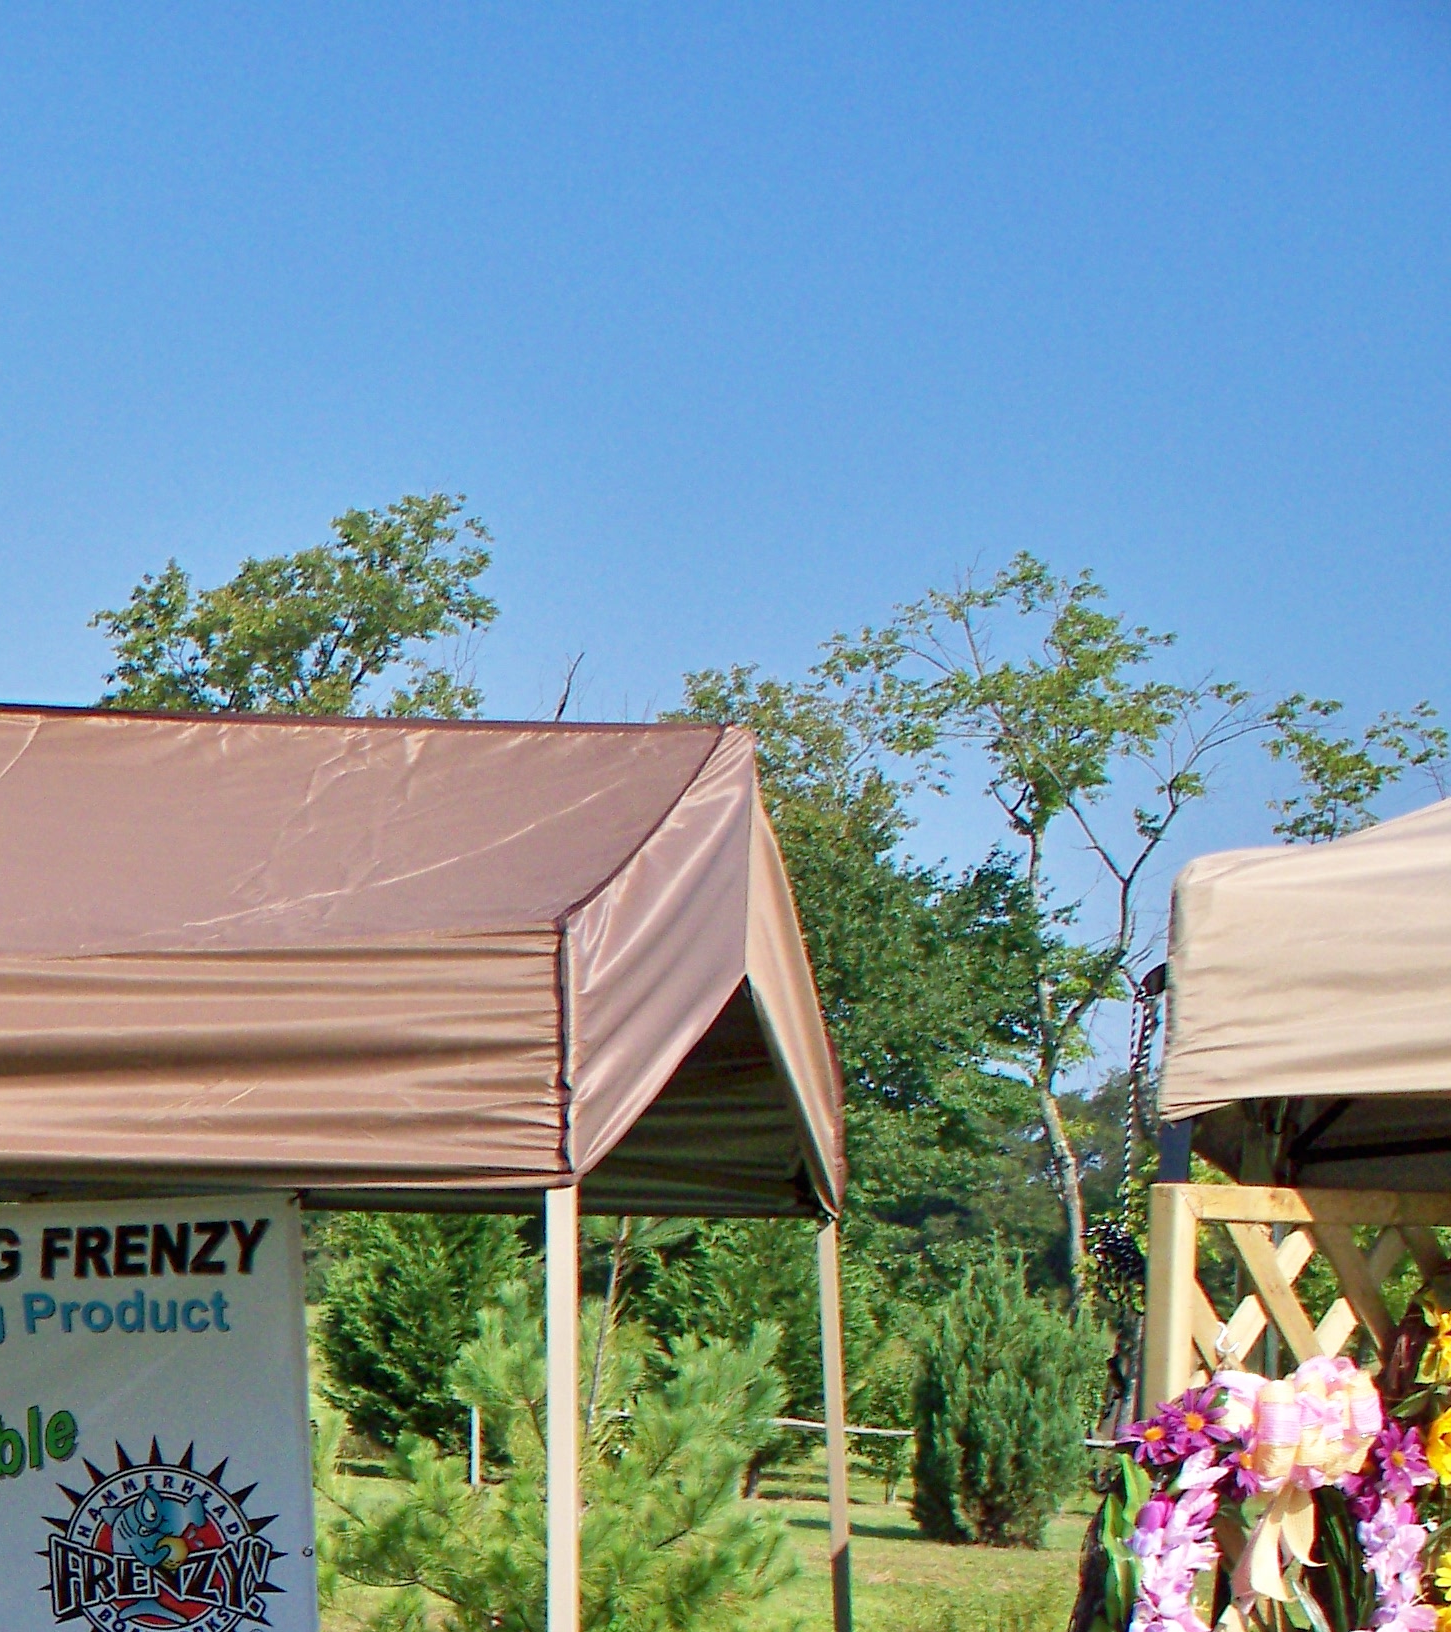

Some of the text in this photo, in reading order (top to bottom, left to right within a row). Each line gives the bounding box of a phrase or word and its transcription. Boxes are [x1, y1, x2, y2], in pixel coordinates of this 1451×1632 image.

[40, 1218, 270, 1280] FRENZY
[22, 1290, 231, 1336] Product
[76, 1474, 241, 1540] HAMMERHEAD
[49, 1534, 273, 1619] FRENZY!
